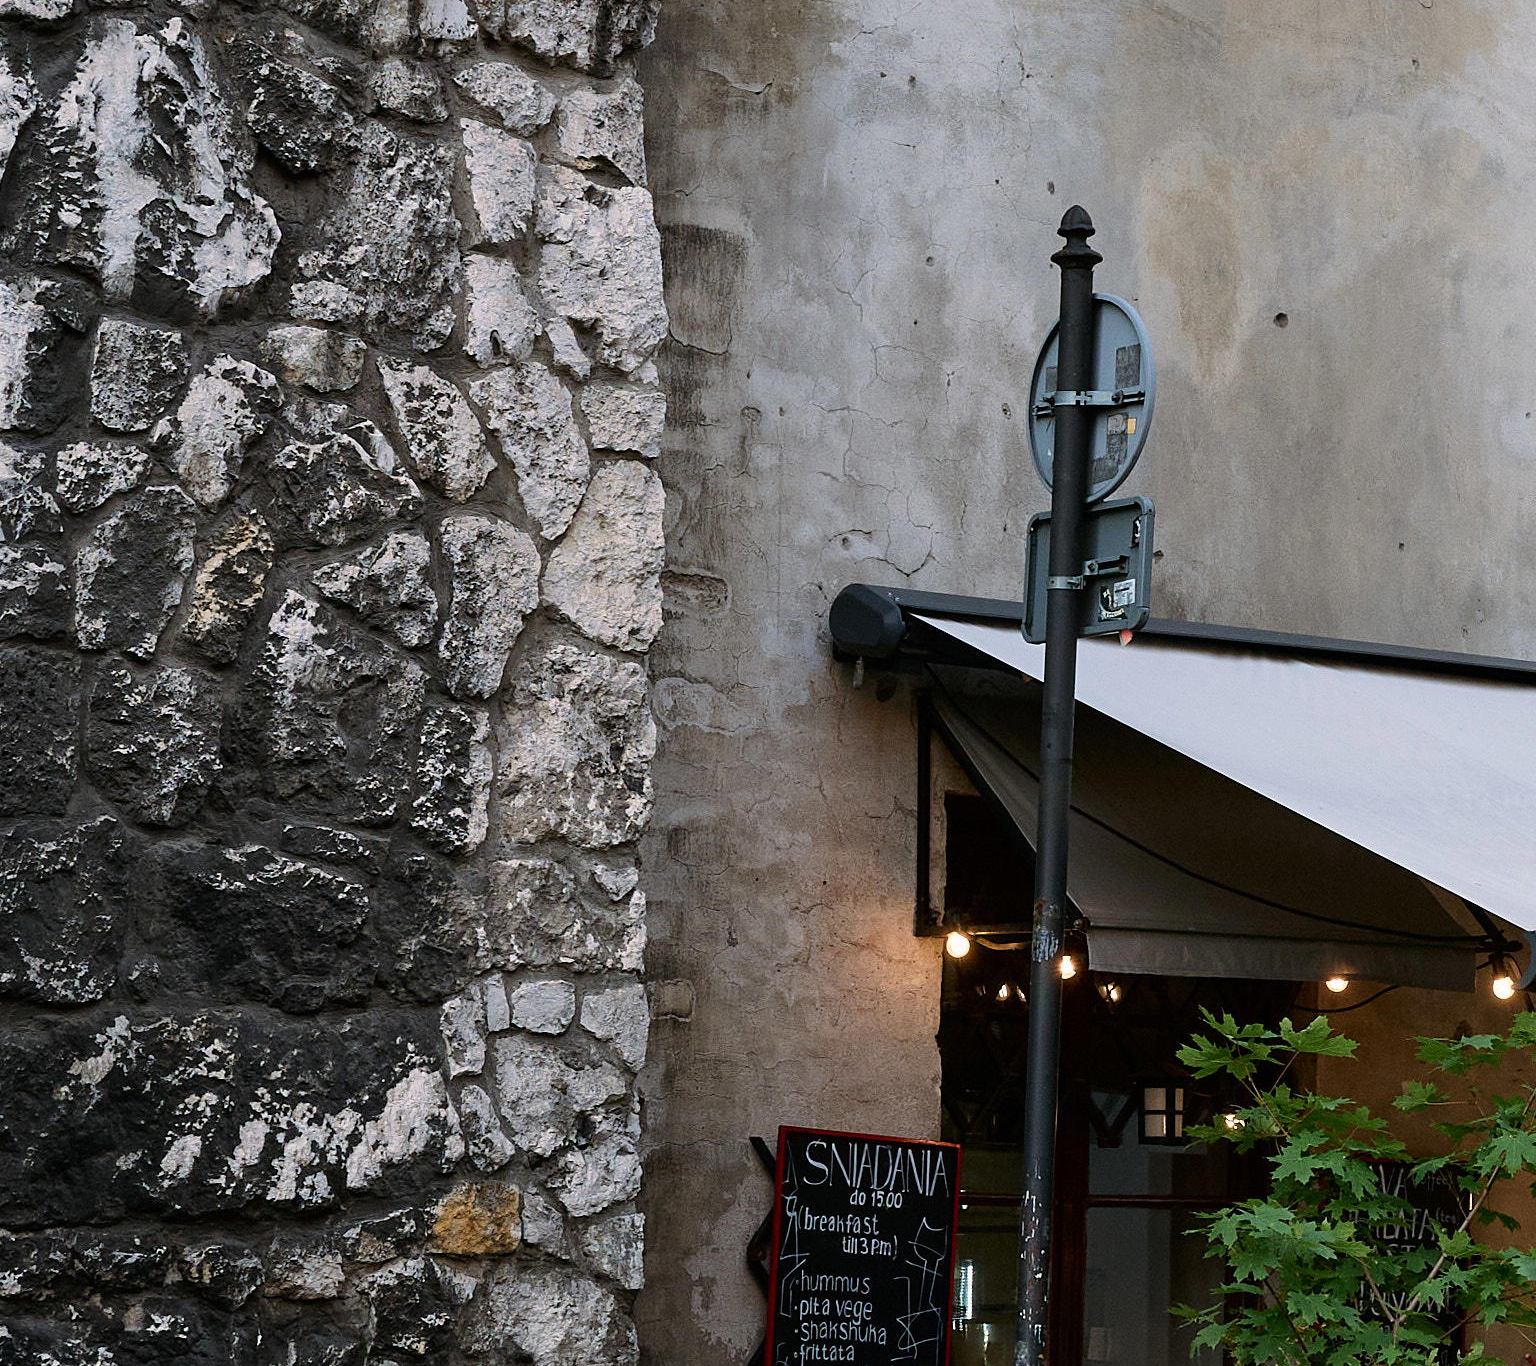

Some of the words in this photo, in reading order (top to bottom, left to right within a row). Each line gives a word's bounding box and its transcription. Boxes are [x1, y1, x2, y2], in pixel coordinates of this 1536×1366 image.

[850, 1189, 866, 1205] do
[799, 1205, 880, 1235] (breakfast
[842, 1235, 858, 1254] till
[860, 1239, 868, 1255] 3
[801, 1269, 871, 1295] hummus
[800, 1298, 831, 1321] pita
[836, 1299, 873, 1325] vege
[800, 1321, 887, 1346] shakshuka
